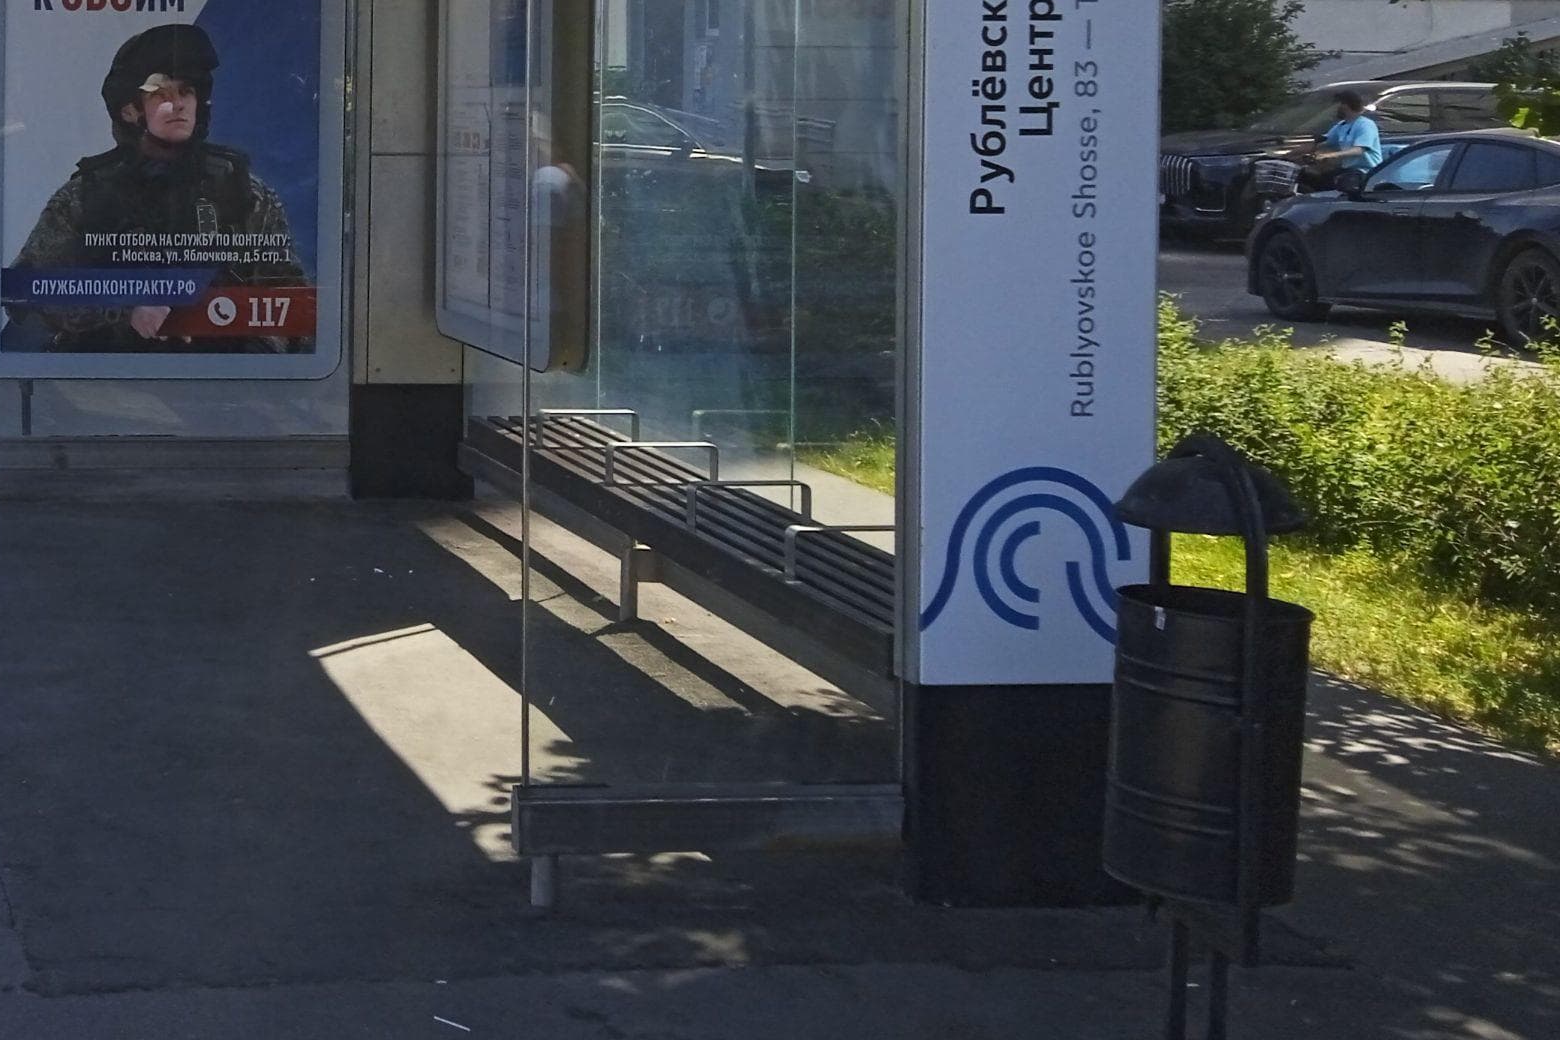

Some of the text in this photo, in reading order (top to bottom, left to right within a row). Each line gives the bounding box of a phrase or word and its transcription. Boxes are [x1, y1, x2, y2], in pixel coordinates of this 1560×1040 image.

[1074, 61, 1098, 97] 83
[1071, 109, 1102, 218] Shosse,
[85, 233, 291, 247] ПУНКТ ОТБОРА НА СЛУЖБУ ПО КОНТРАКТУ:
[112, 252, 120, 262] г.
[122, 250, 165, 264] Москва,
[167, 252, 182, 264] ул.
[183, 249, 241, 264] Яблочкова,
[261, 252, 282, 264] стр.
[284, 249, 291, 261] 1
[32, 279, 196, 296] СЛУЖБАПОКОНТРАКТУ.РФ
[248, 297, 291, 327] 117
[1069, 232, 1100, 416] Rublyovskoe
